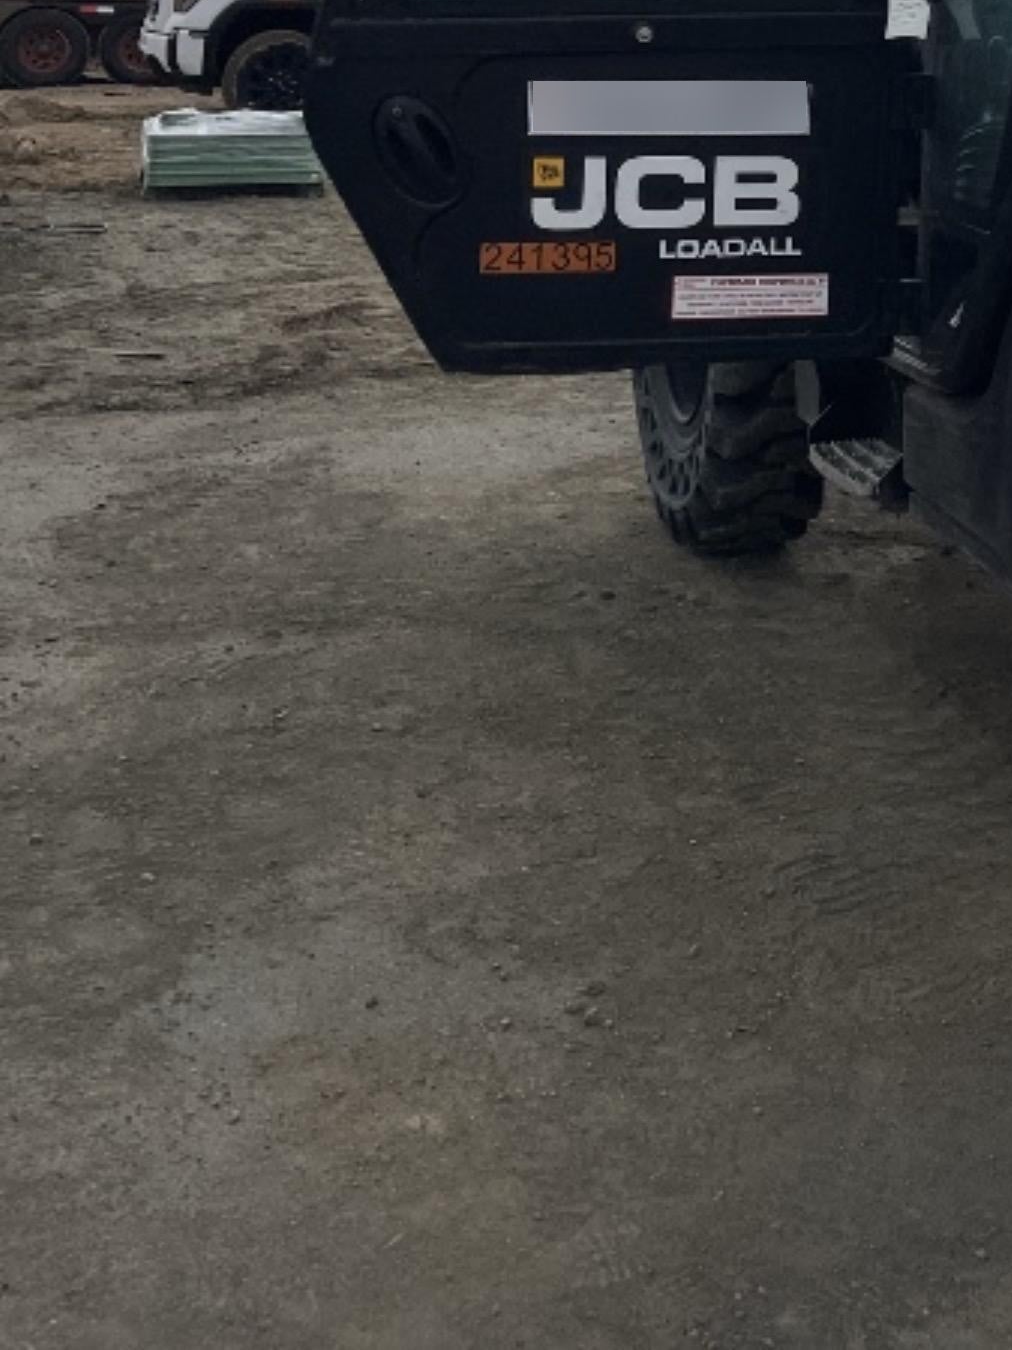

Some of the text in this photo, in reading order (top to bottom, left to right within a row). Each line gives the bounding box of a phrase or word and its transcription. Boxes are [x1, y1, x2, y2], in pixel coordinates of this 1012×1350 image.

[530, 155, 800, 230] JCB
[484, 242, 613, 271] 241395
[659, 237, 802, 259] LOADALL
